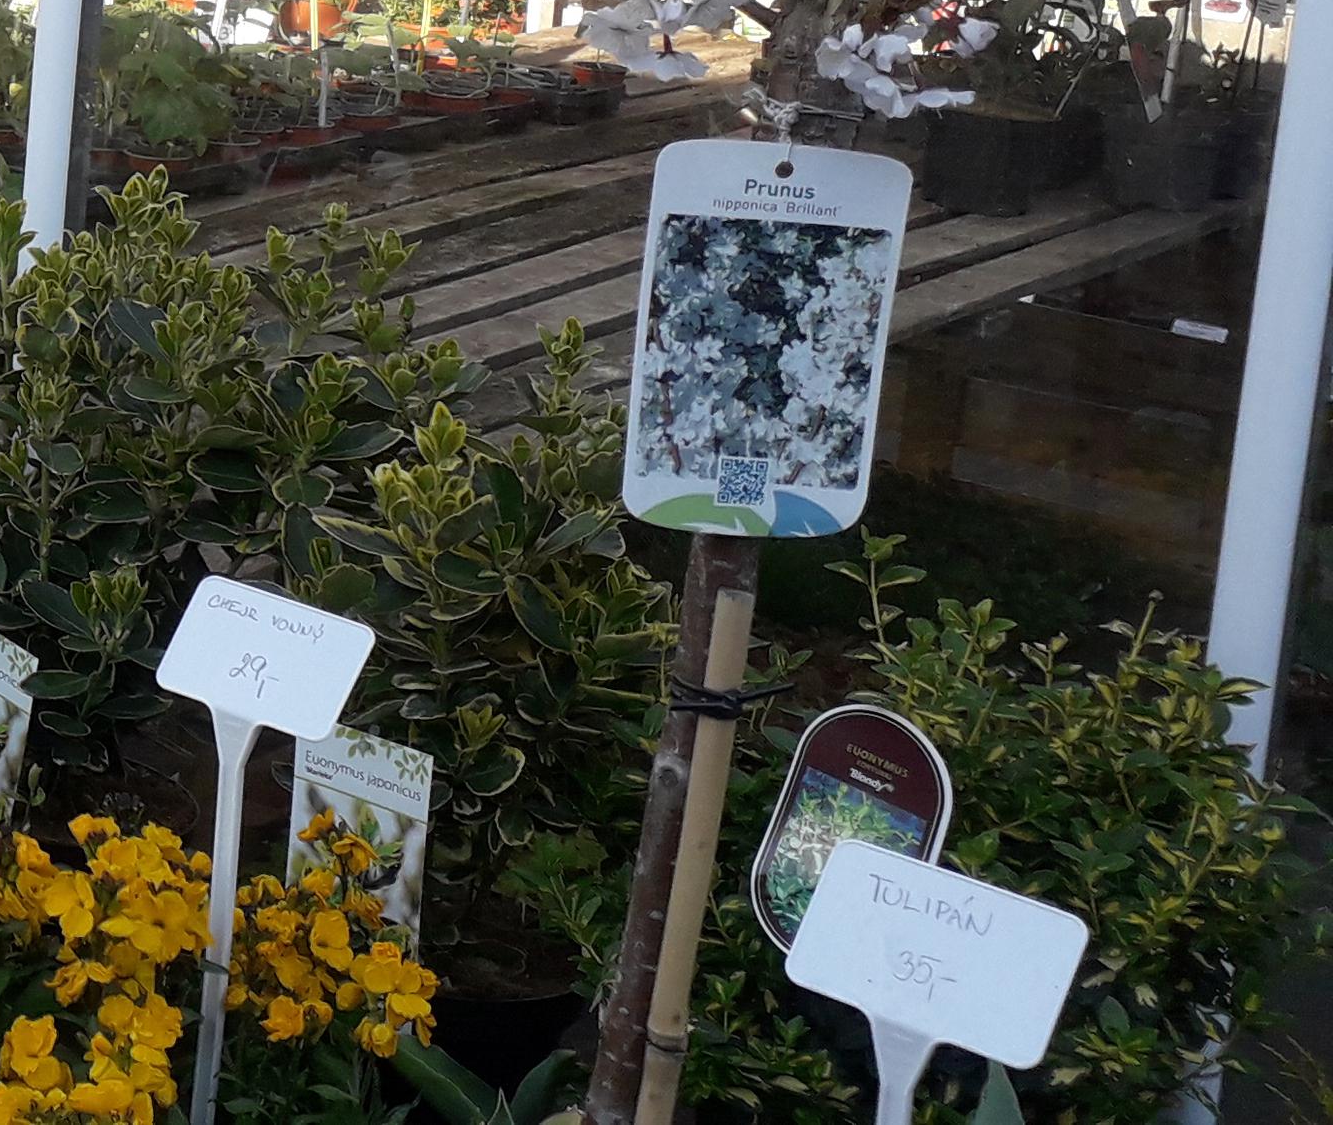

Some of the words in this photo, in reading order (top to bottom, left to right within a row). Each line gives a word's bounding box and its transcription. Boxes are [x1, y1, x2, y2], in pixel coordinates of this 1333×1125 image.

[744, 178, 815, 199] Prunus
[712, 198, 778, 213] nipponica
[272, 615, 324, 644] VONNÝ
[305, 750, 365, 781] Euonymus
[367, 773, 422, 802] japonicus
[846, 743, 910, 778] EUONYMUS
[869, 873, 993, 936] TULIPÁN
